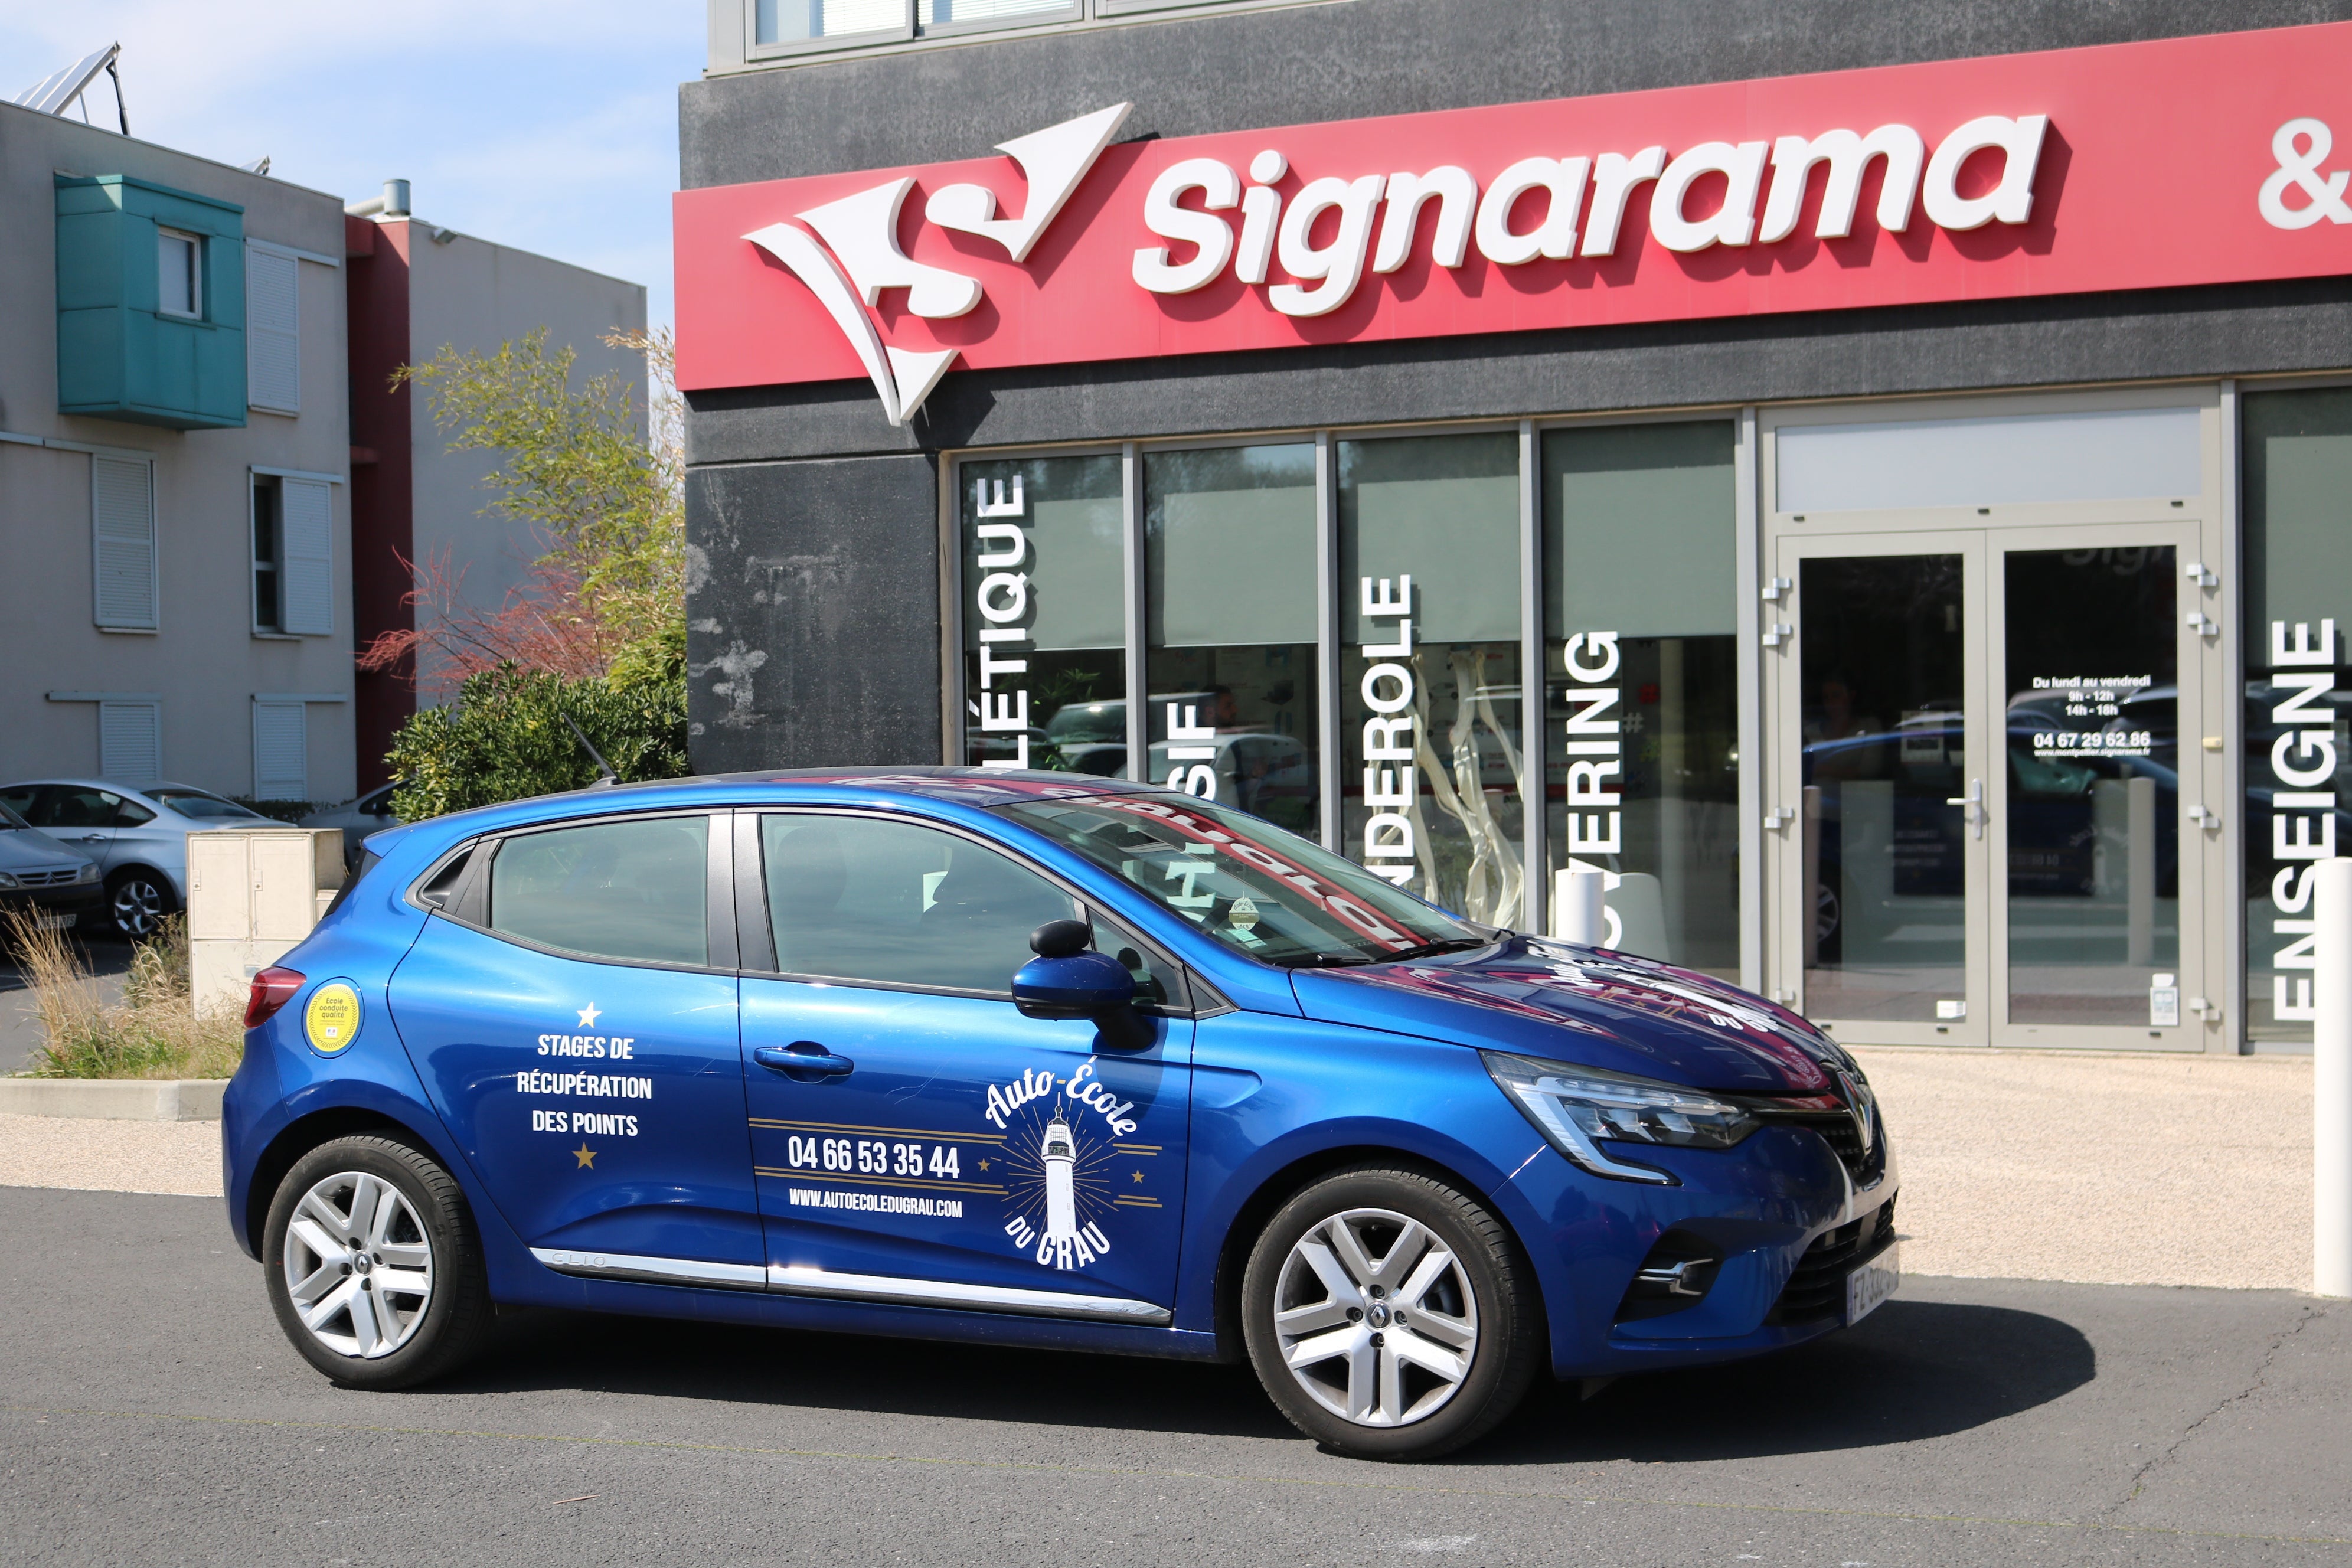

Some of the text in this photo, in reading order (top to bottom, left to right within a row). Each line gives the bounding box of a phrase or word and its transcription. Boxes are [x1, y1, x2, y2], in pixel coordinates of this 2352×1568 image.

[1132, 113, 2352, 318] Signarama &
[2033, 674, 2152, 688] Du lundi au vendredi
[2068, 690, 2083, 702] 9h
[2093, 689, 2115, 701] 12h
[2065, 704, 2088, 716] 14h
[2096, 703, 2119, 716] 18h
[2033, 731, 2151, 749] 04 67 29 62 86
[321, 1011, 345, 1019] qualité
[537, 1034, 635, 1060] STAGES DE
[517, 1069, 652, 1099] RÉCUPÉRATION
[532, 1110, 639, 1136] DES POINTS
[788, 1136, 961, 1180] 04 66 53 35 44
[789, 1188, 963, 1218] WWW.AUTOECOLEDUGRAU.COM
[1004, 1215, 1111, 1270] DU GRAU
[552, 1252, 606, 1268] CLIO
